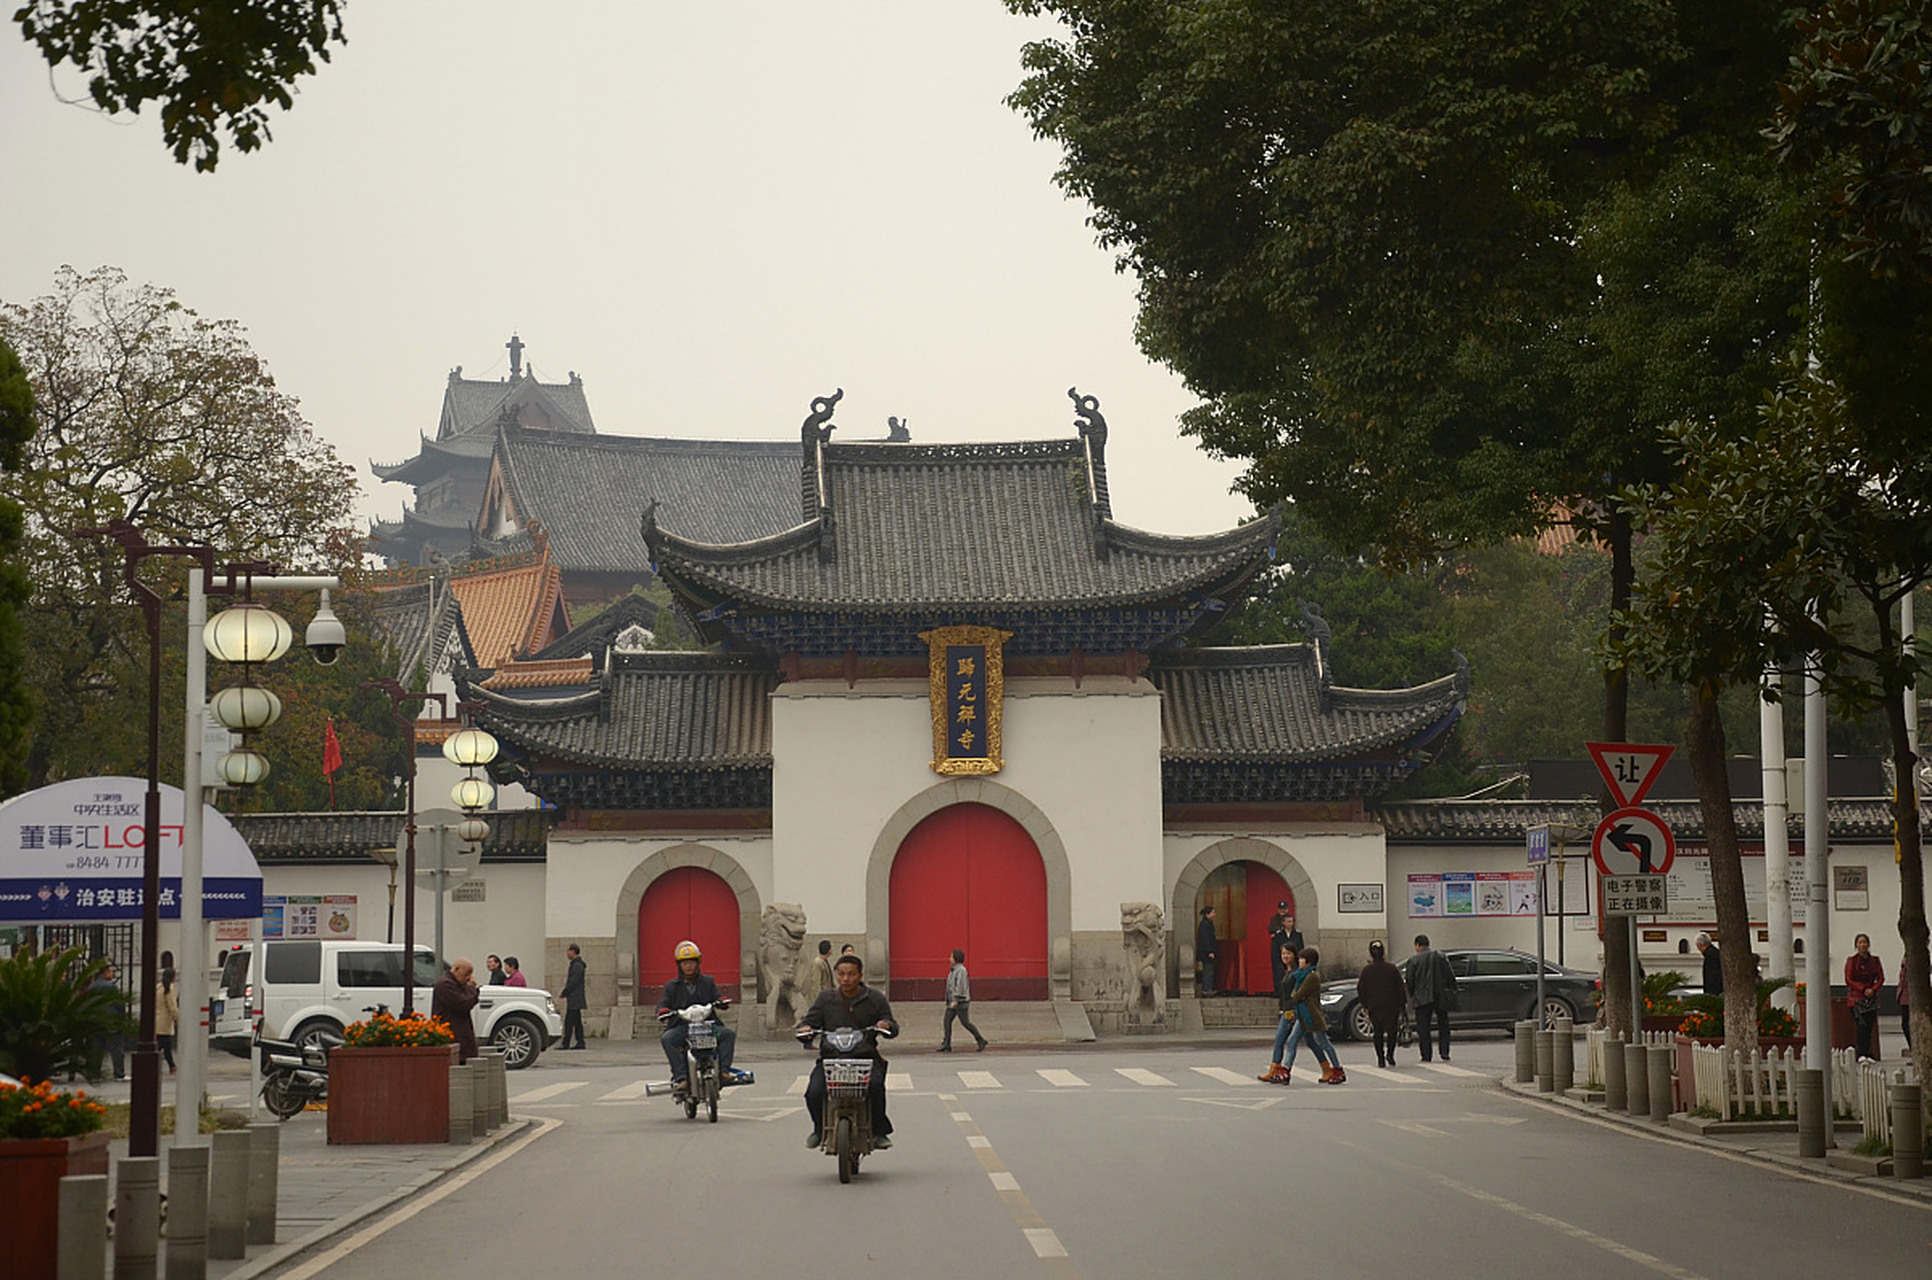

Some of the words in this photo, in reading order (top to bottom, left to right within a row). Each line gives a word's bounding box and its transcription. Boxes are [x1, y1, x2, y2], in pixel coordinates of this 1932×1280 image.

[1615, 756, 1639, 783] 让
[74, 804, 140, 816] 中央生活区
[76, 856, 109, 869] 8484
[1607, 880, 1661, 893] 电子警察
[1360, 892, 1380, 901] 入口
[1608, 898, 1662, 911] 正在摄像
